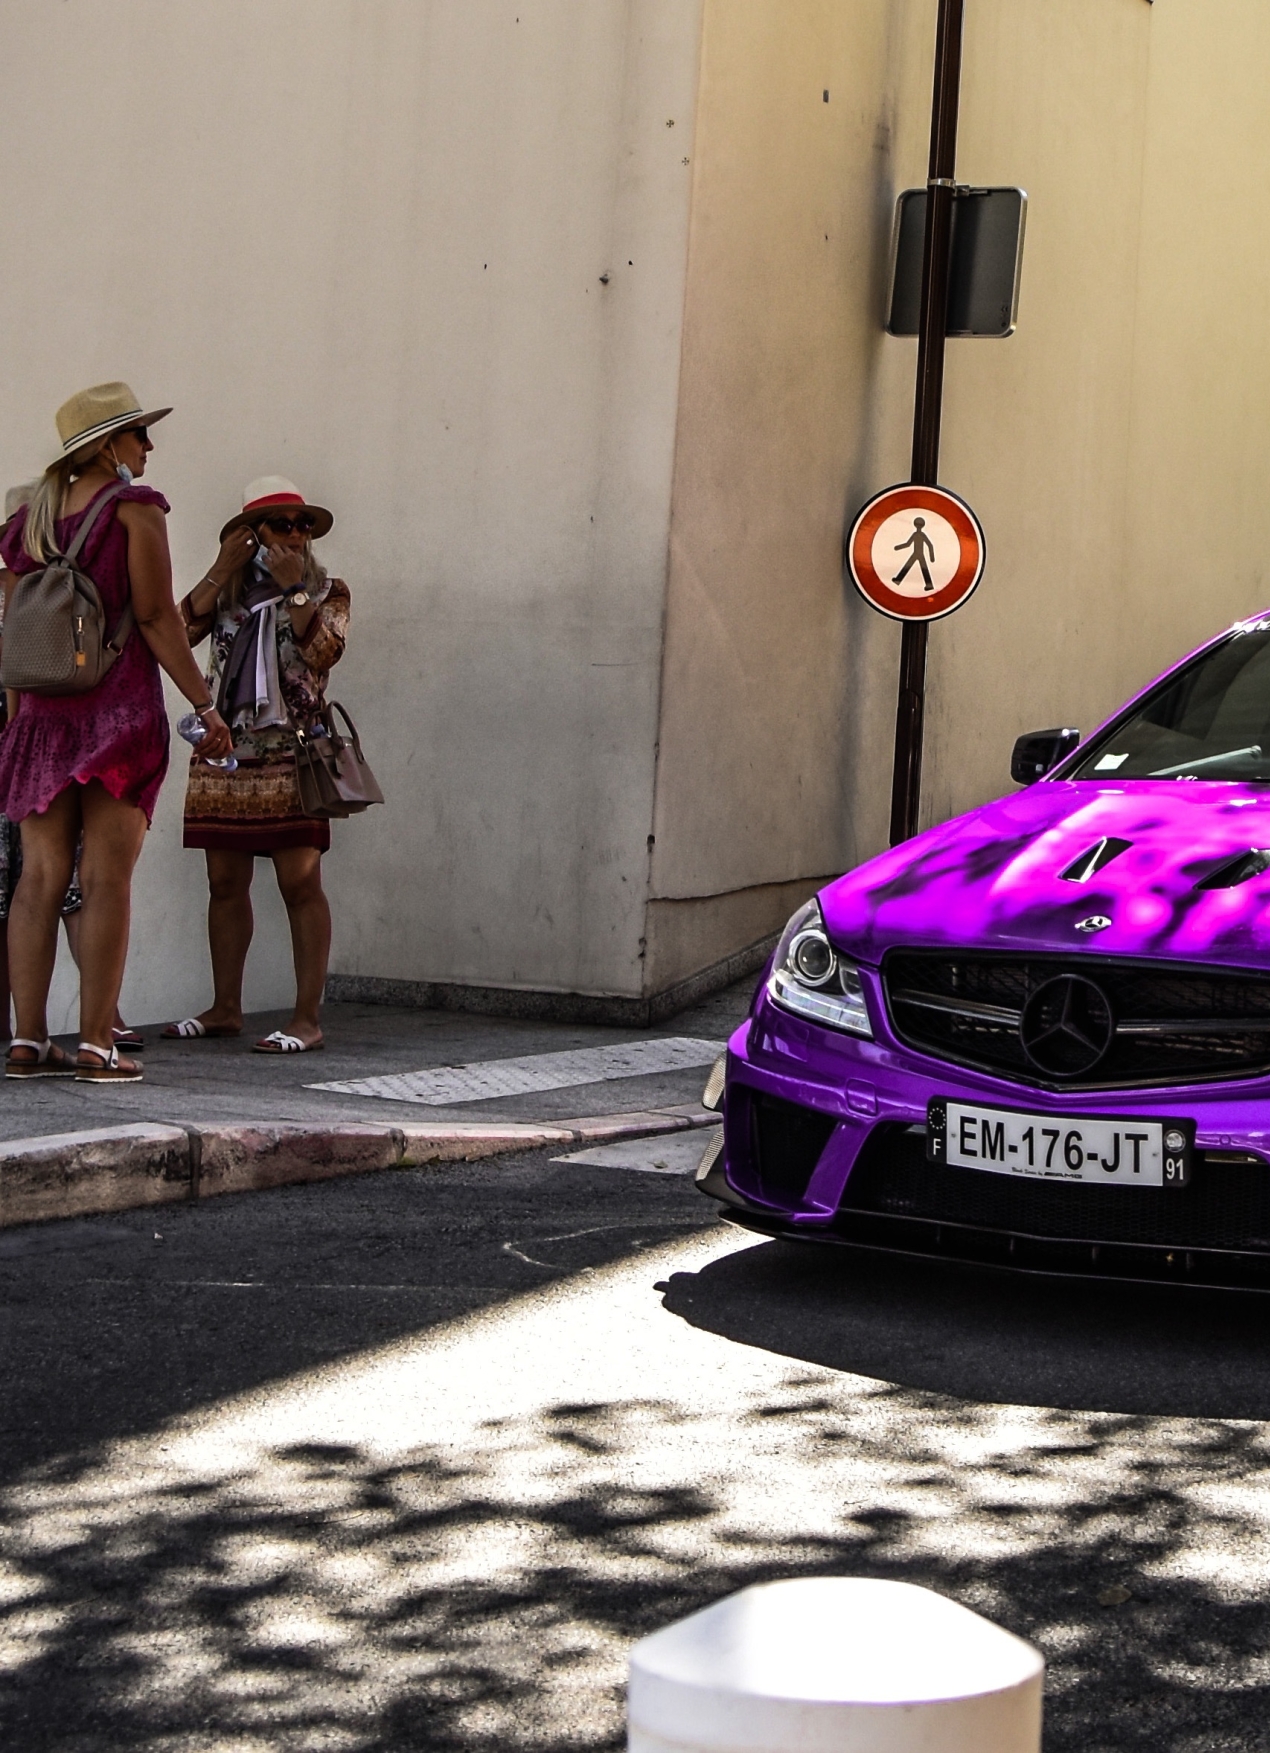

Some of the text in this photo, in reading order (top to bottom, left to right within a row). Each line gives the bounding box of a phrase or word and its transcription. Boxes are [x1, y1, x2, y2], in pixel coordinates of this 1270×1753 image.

[932, 1138, 942, 1156] F
[959, 1115, 1149, 1173] EM-176-JT
[1165, 1158, 1184, 1180] 91
